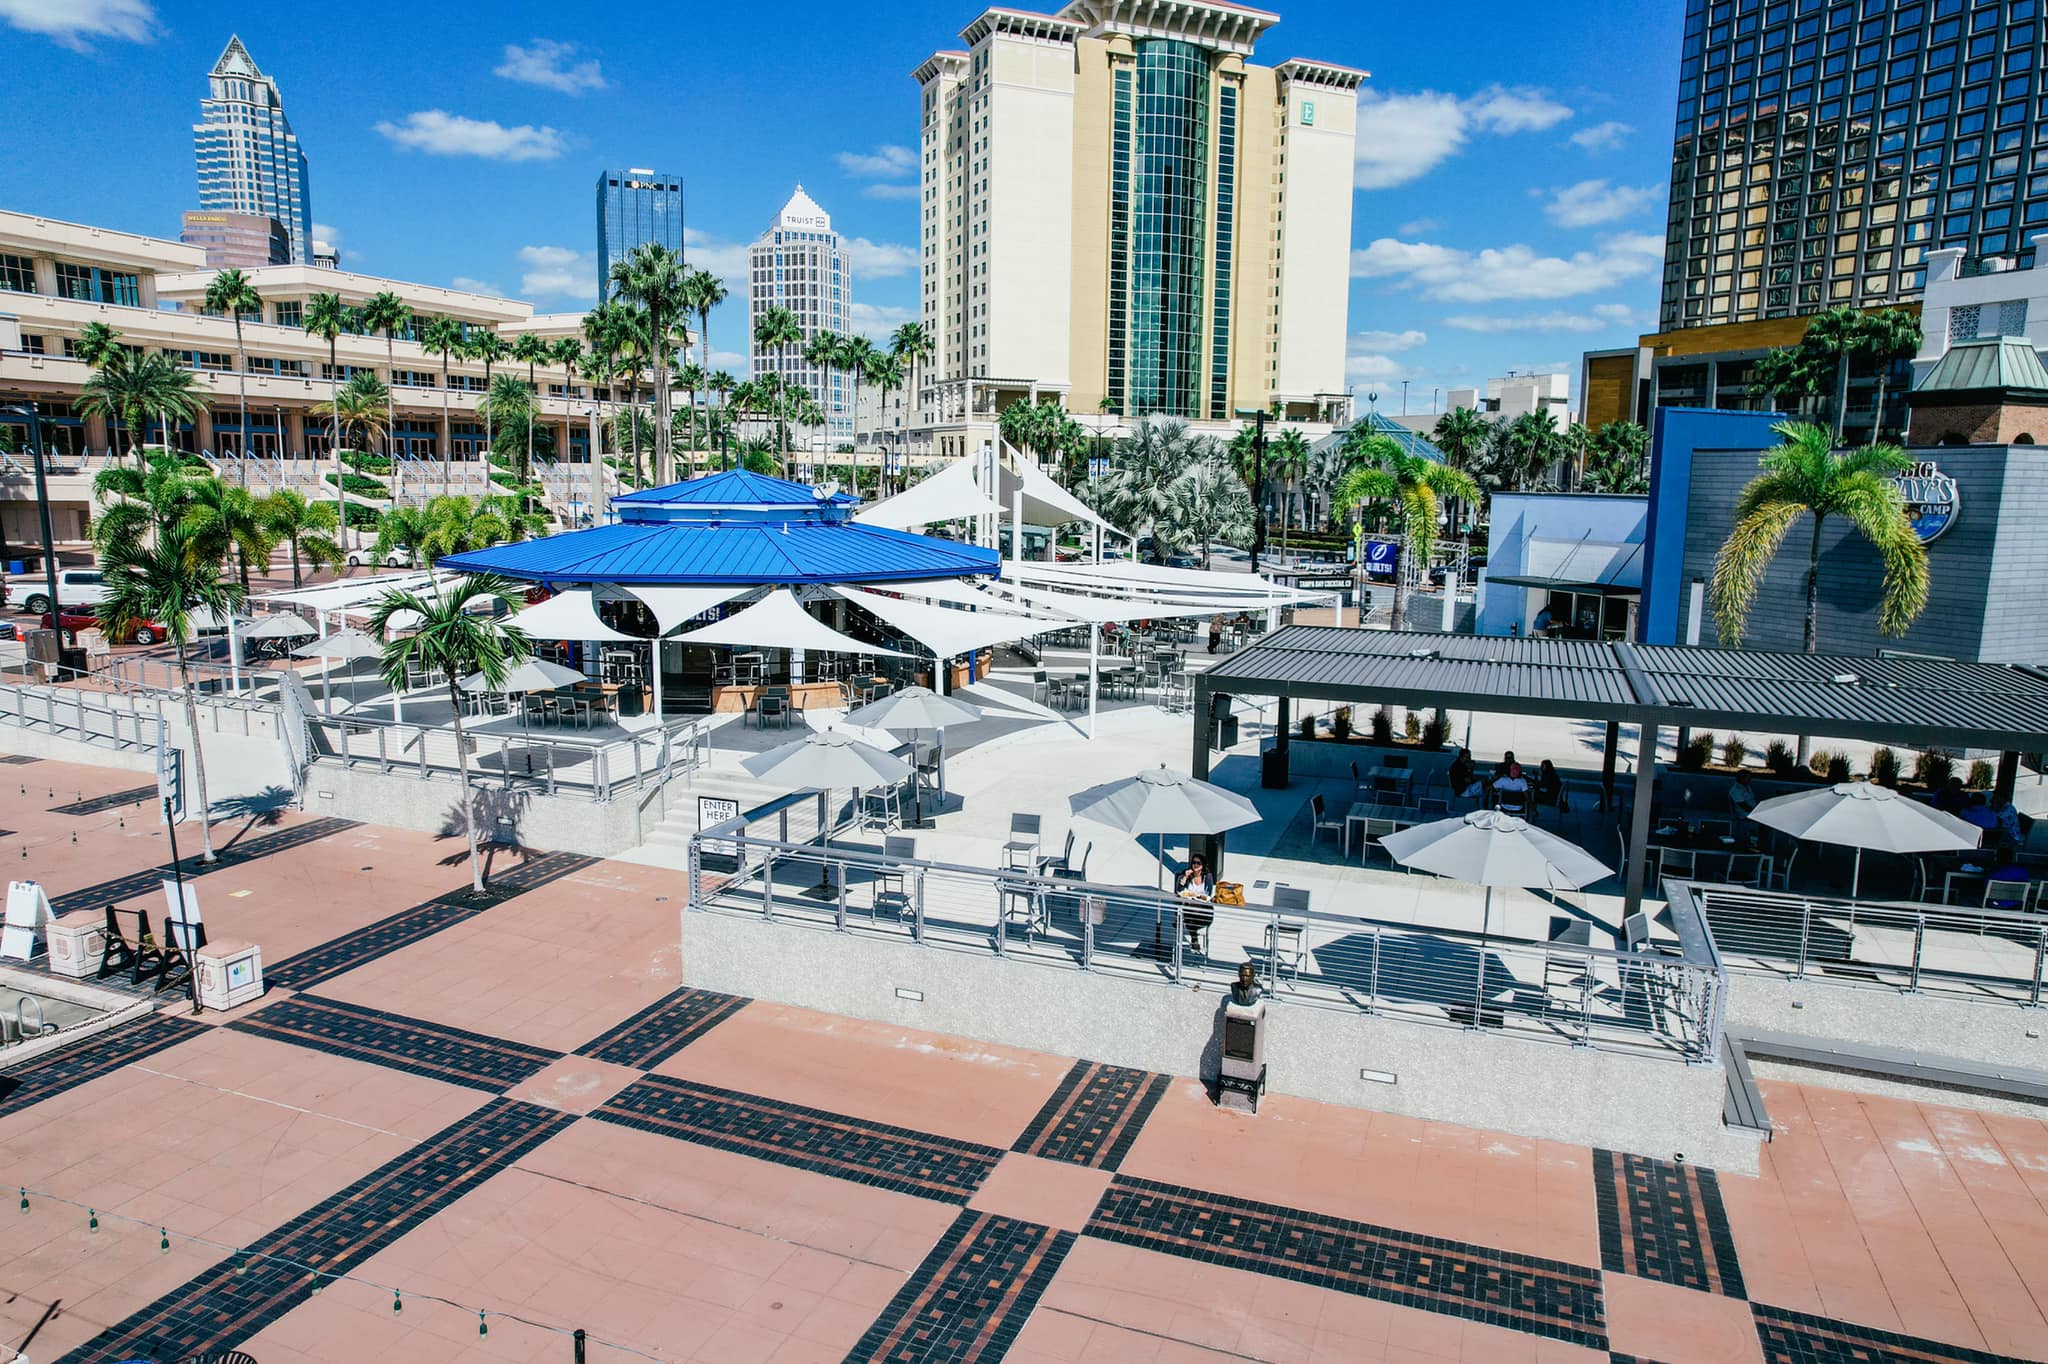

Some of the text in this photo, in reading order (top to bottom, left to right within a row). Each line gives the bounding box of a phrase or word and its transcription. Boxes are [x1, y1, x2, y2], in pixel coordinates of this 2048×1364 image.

[640, 181, 657, 190] PNC
[786, 216, 813, 224] TRUIST
[1920, 504, 1951, 515] CAMP
[690, 607, 720, 621] LTS!
[703, 800, 733, 811] ENTER
[706, 810, 731, 821] HERE
